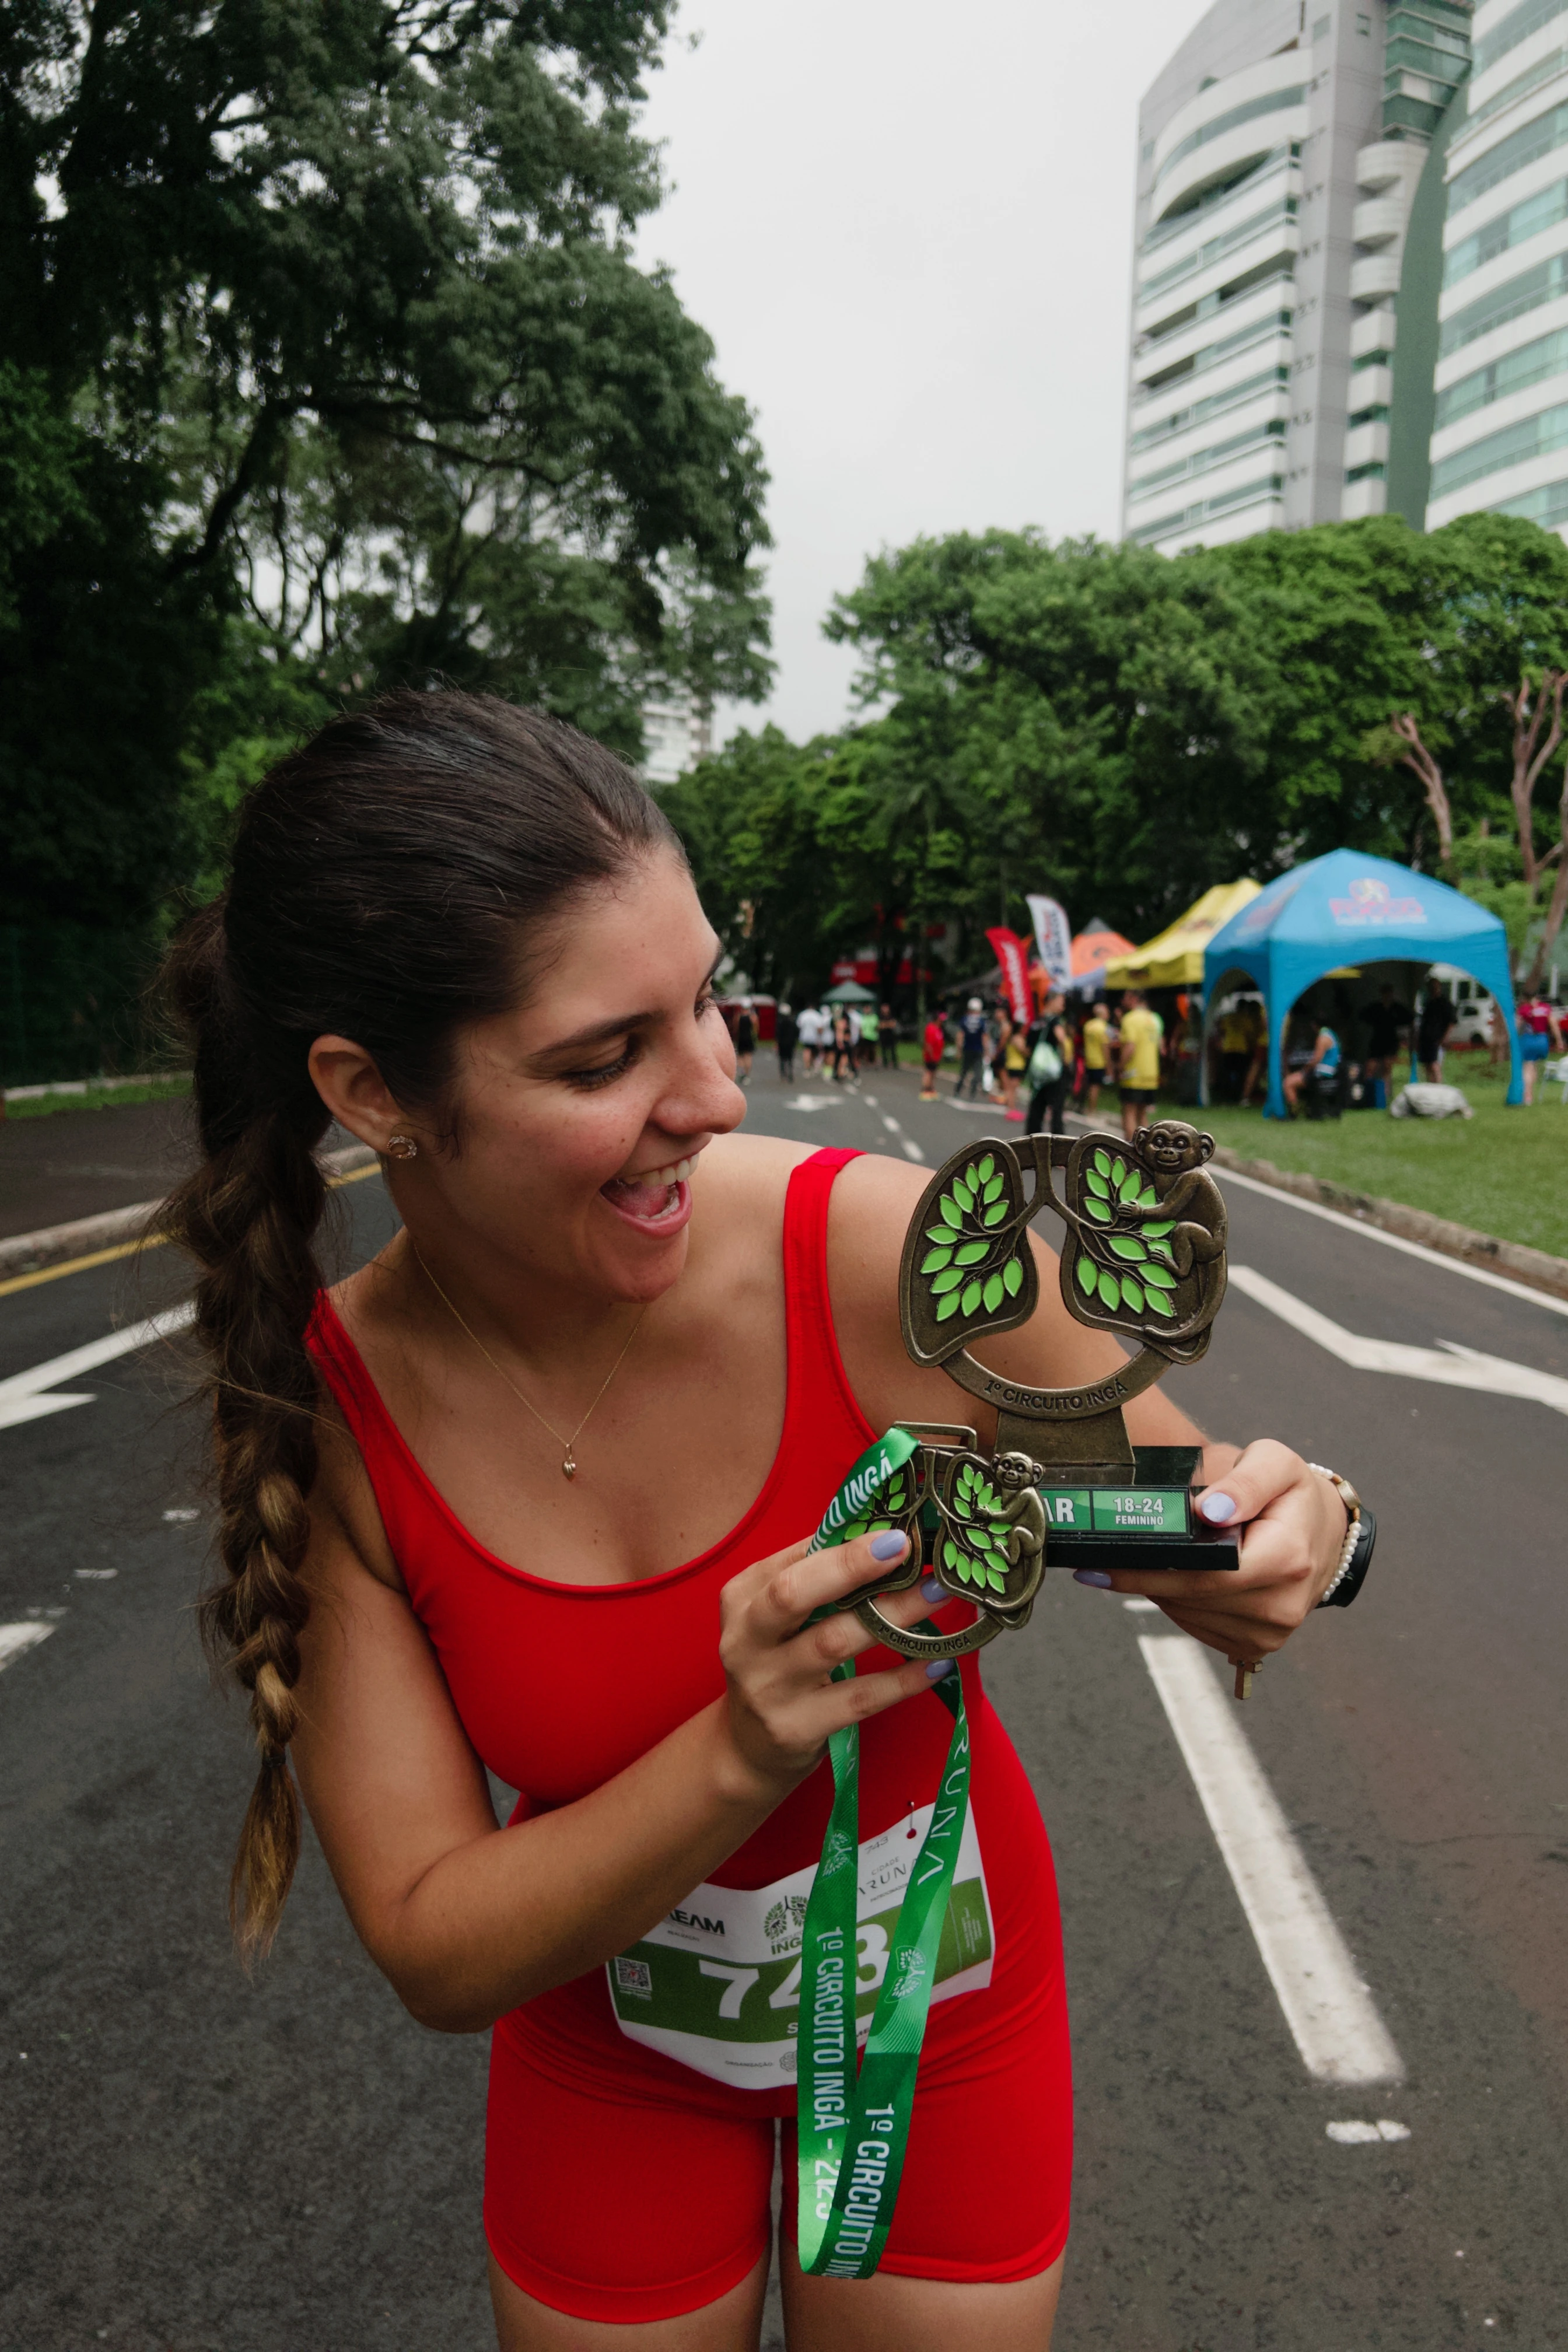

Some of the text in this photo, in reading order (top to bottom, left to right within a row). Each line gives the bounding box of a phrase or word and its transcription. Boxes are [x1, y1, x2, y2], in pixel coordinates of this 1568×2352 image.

[1003, 1388, 1083, 1410] CIRCUITO
[1086, 1378, 1129, 1408] INGÁ
[844, 1448, 893, 1515] INGÁ
[1114, 1497, 1164, 1513] 18-24
[1115, 1516, 1164, 1526] FEMININO
[889, 1632, 941, 1653] CIRCUITO
[944, 1633, 971, 1651] INGÁ
[918, 1707, 970, 1886] RUNA
[872, 1856, 900, 1875] CIDADE
[771, 1937, 803, 1955] ING
[813, 1957, 845, 2064] CIRCUITO
[814, 2071, 850, 2132] INGÁ
[834, 2140, 890, 2255] CIRCUITO
